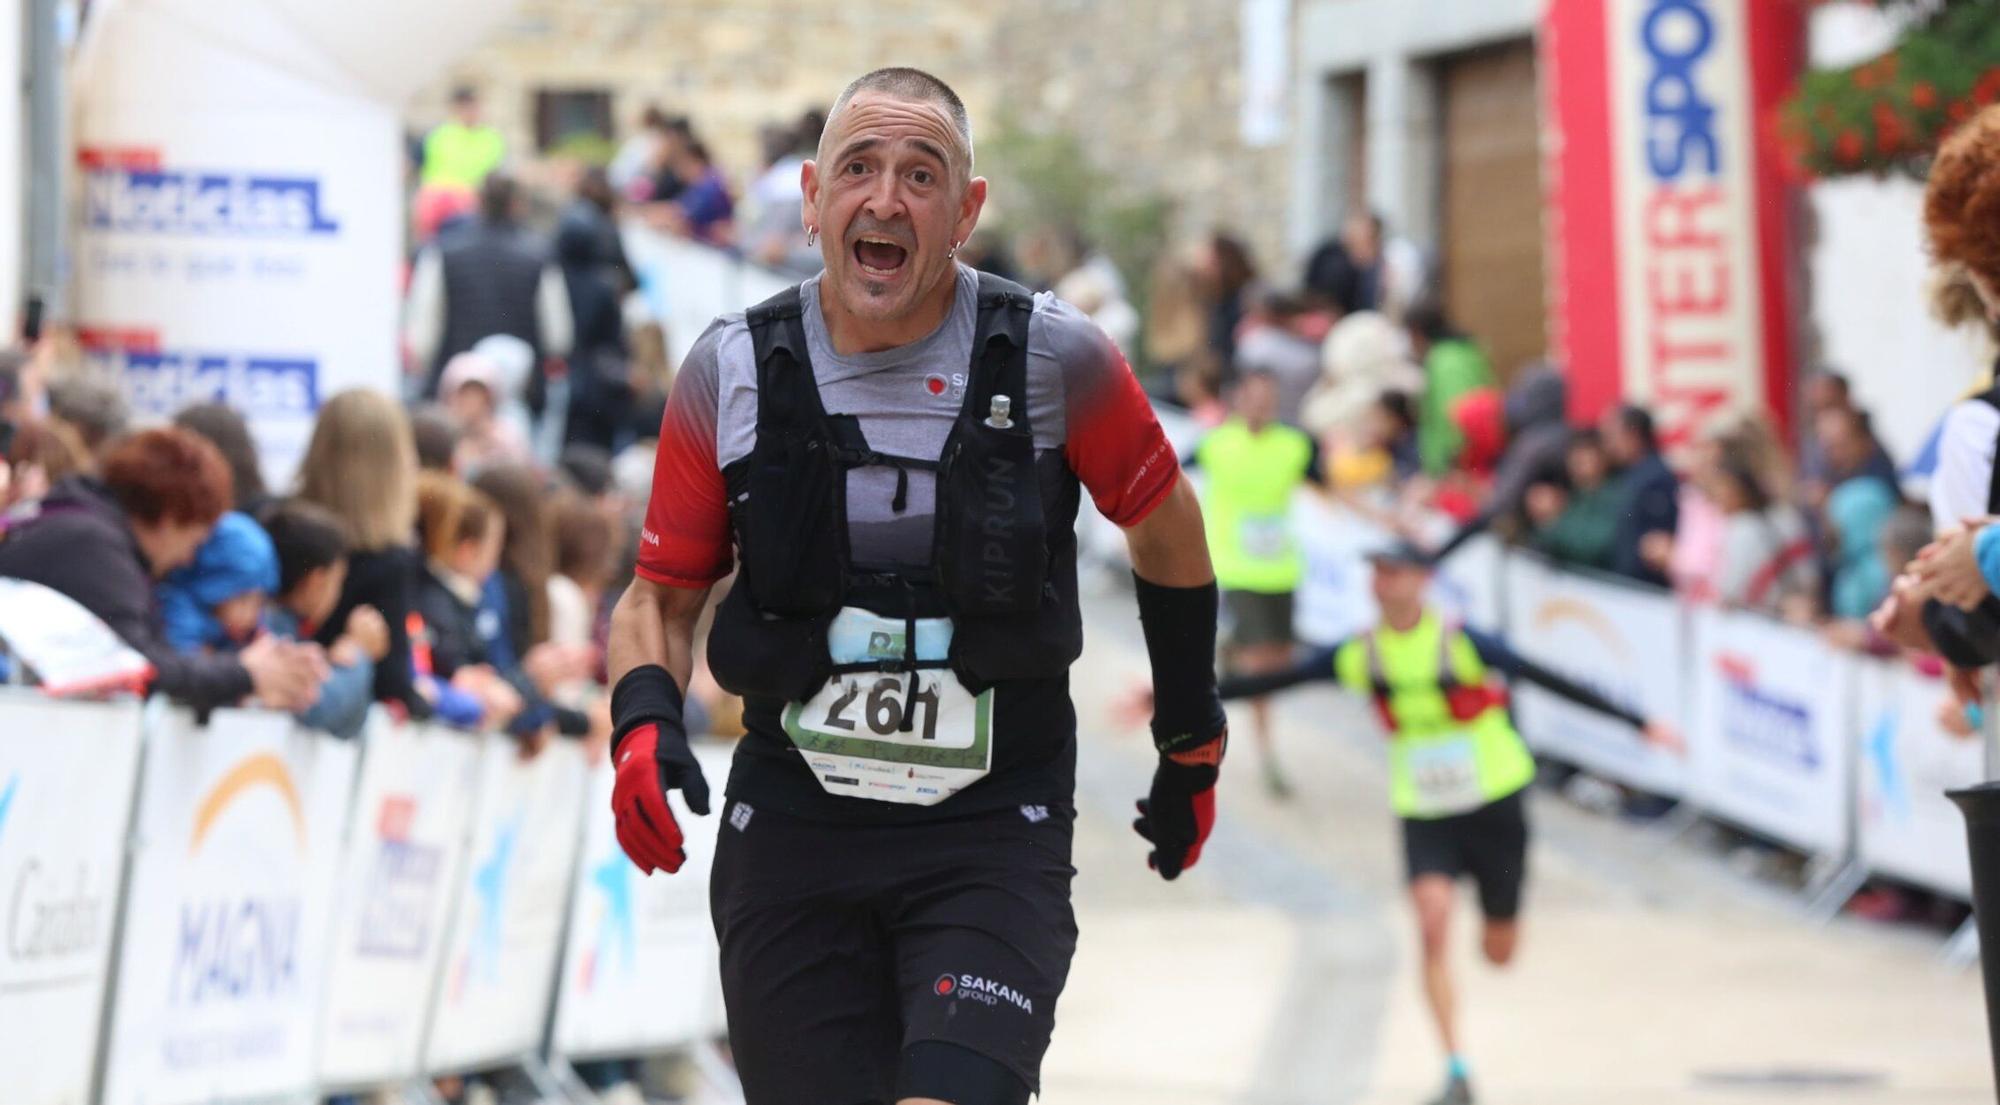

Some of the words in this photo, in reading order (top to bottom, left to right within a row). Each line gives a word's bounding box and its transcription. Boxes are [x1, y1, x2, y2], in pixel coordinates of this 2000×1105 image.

[88, 170, 316, 233] Noticias
[984, 457, 1015, 605] KIPRUN
[824, 674, 940, 740] 261
[958, 988, 998, 1006] group
[960, 974, 1032, 1015] SAKANA
